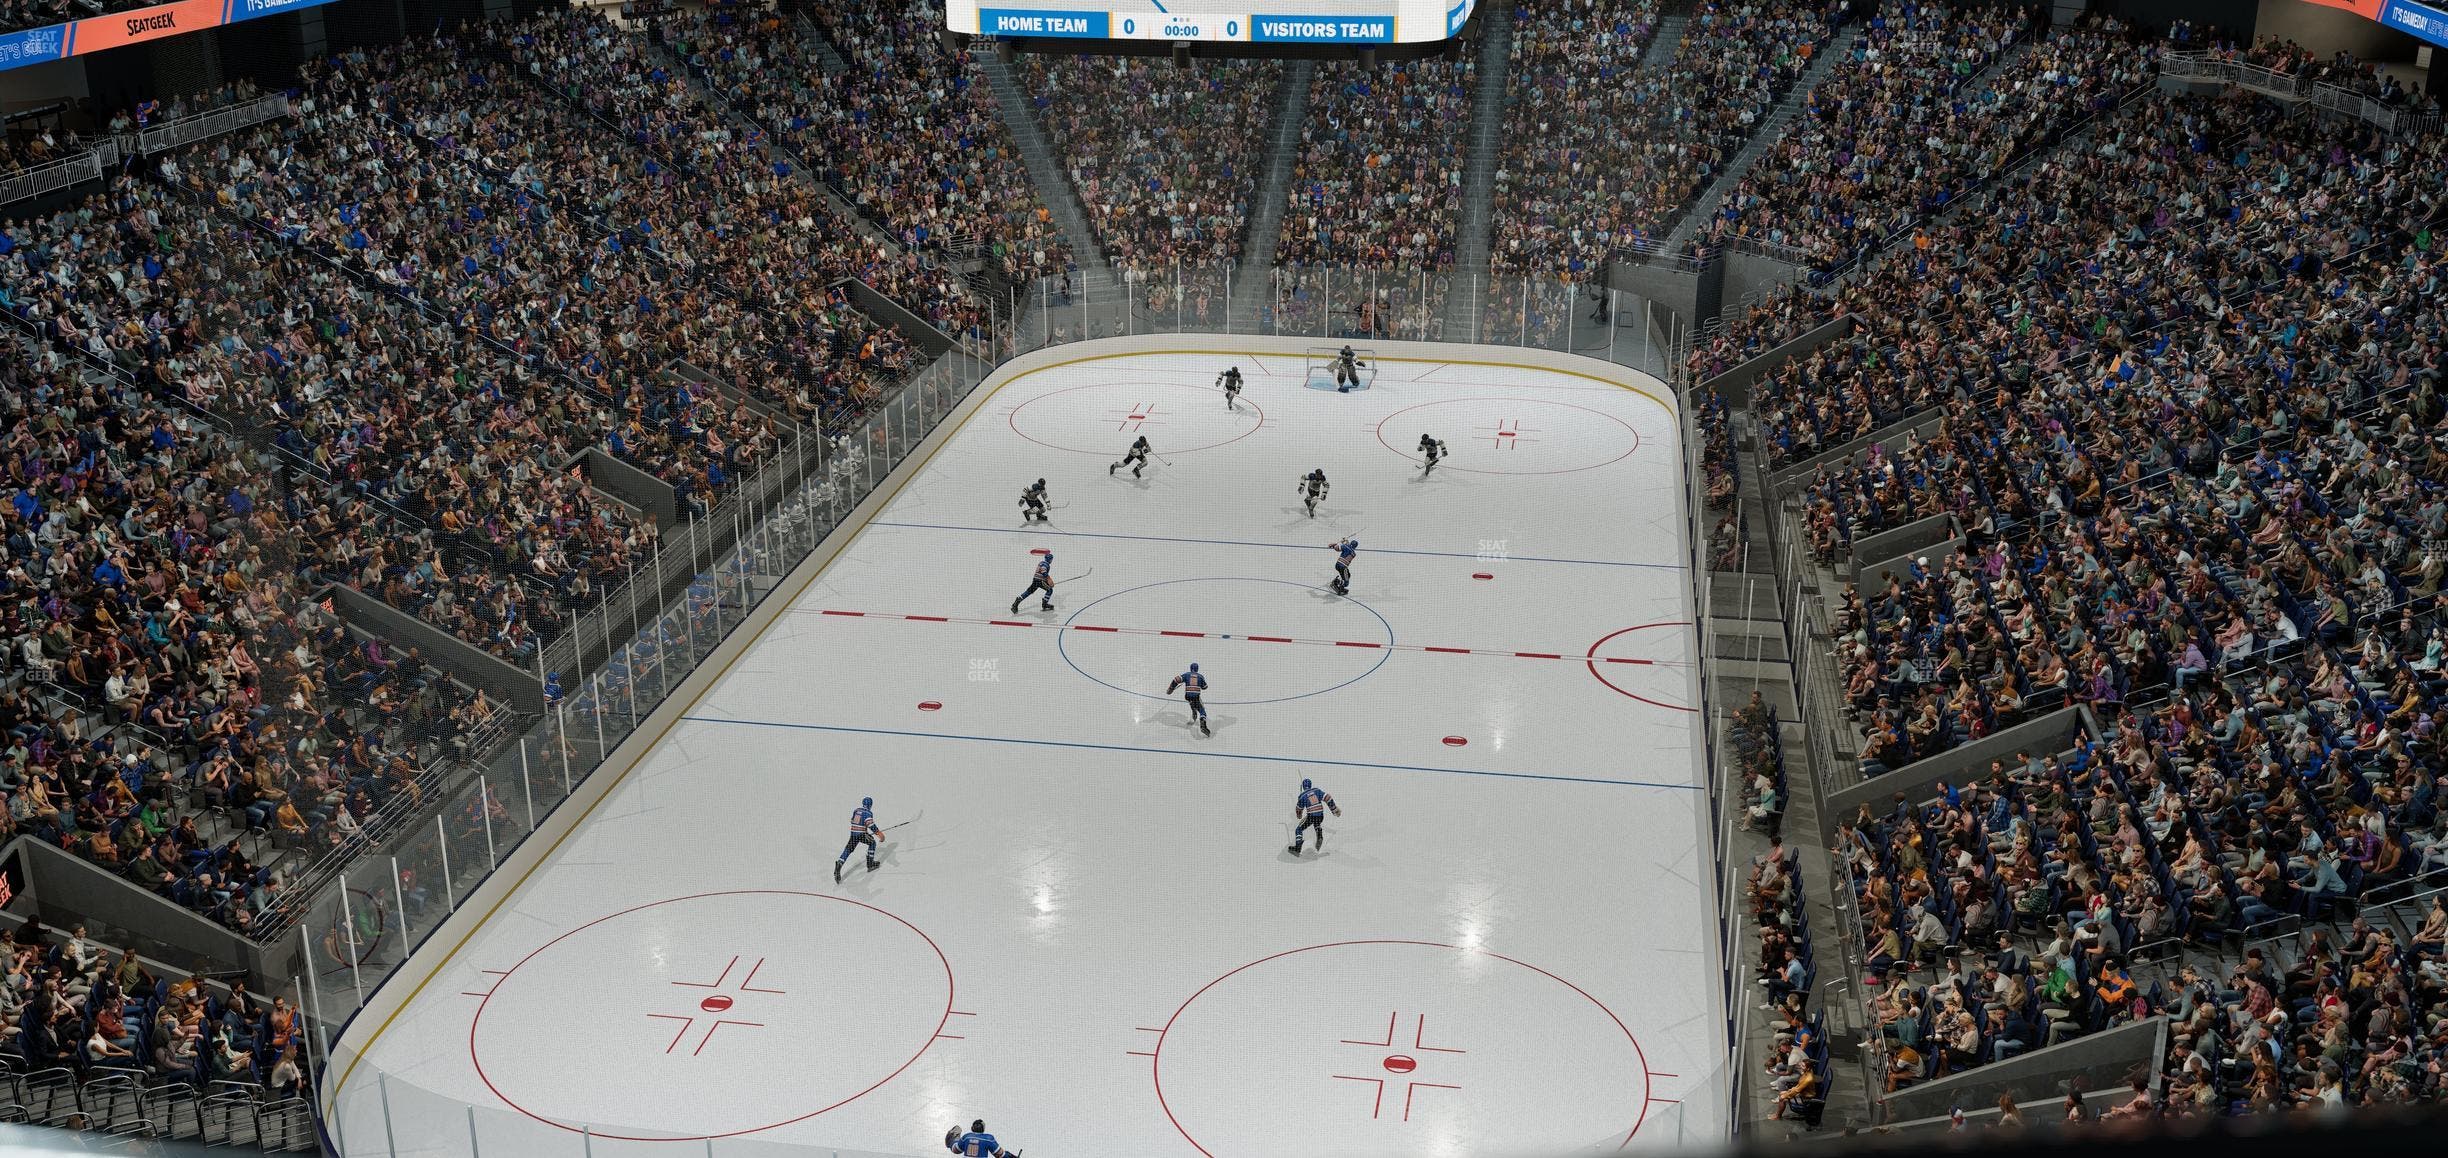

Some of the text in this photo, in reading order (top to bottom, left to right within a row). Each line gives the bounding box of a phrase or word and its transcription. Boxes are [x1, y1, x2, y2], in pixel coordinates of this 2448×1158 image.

[127, 11, 176, 37] SEATGEEK
[998, 16, 1088, 33] HOME TEAM
[1123, 18, 1135, 35] 0
[1164, 25, 1199, 37] 00:00
[1226, 20, 1238, 37] 0
[1262, 22, 1385, 38] VISITORS TEAM
